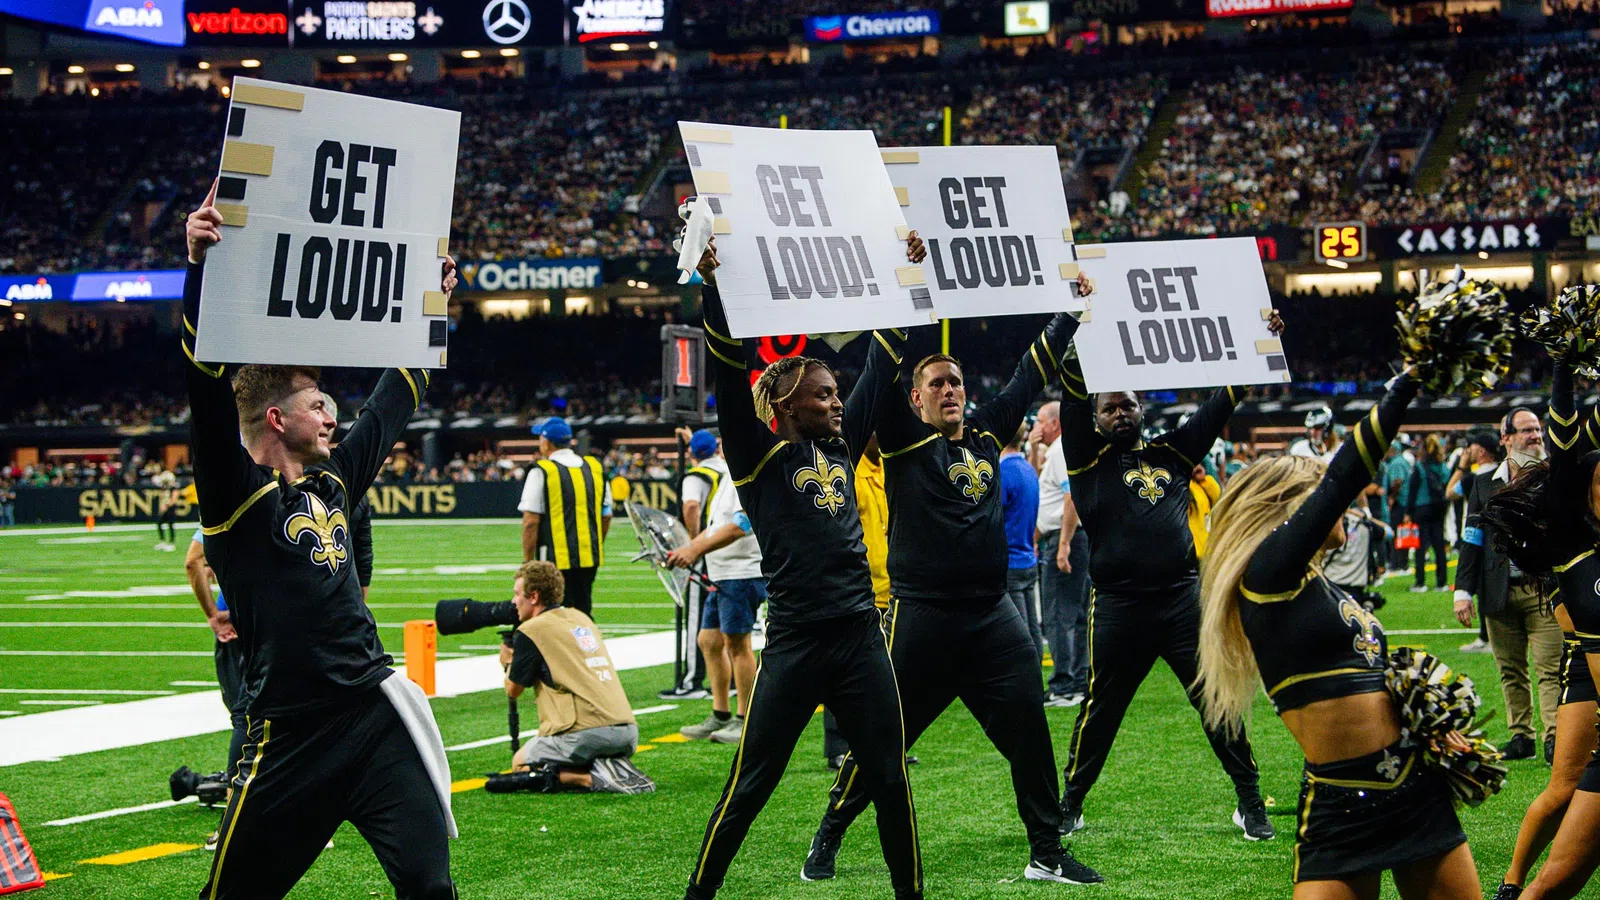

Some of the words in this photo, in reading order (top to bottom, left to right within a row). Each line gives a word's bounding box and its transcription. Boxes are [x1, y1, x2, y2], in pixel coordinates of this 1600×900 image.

[96, 7, 163, 27] ABM
[188, 8, 287, 34] verizon
[325, 17, 415, 39] PARTNERS
[846, 15, 931, 36] Chevron
[309, 139, 397, 229] GET
[756, 164, 832, 227] GET
[938, 176, 1009, 229] GET
[1321, 226, 1360, 258] 25
[1397, 222, 1541, 252] CAESARS
[267, 233, 407, 323] LOUD!
[478, 262, 600, 291] Ochsner
[756, 235, 880, 300] LOUD!
[928, 235, 1044, 291] LOUD!
[6, 284, 53, 300] ABM
[105, 281, 152, 298] ABM
[1126, 266, 1200, 313] GET
[1117, 316, 1237, 365] LOUD!
[367, 484, 456, 514] AINTS
